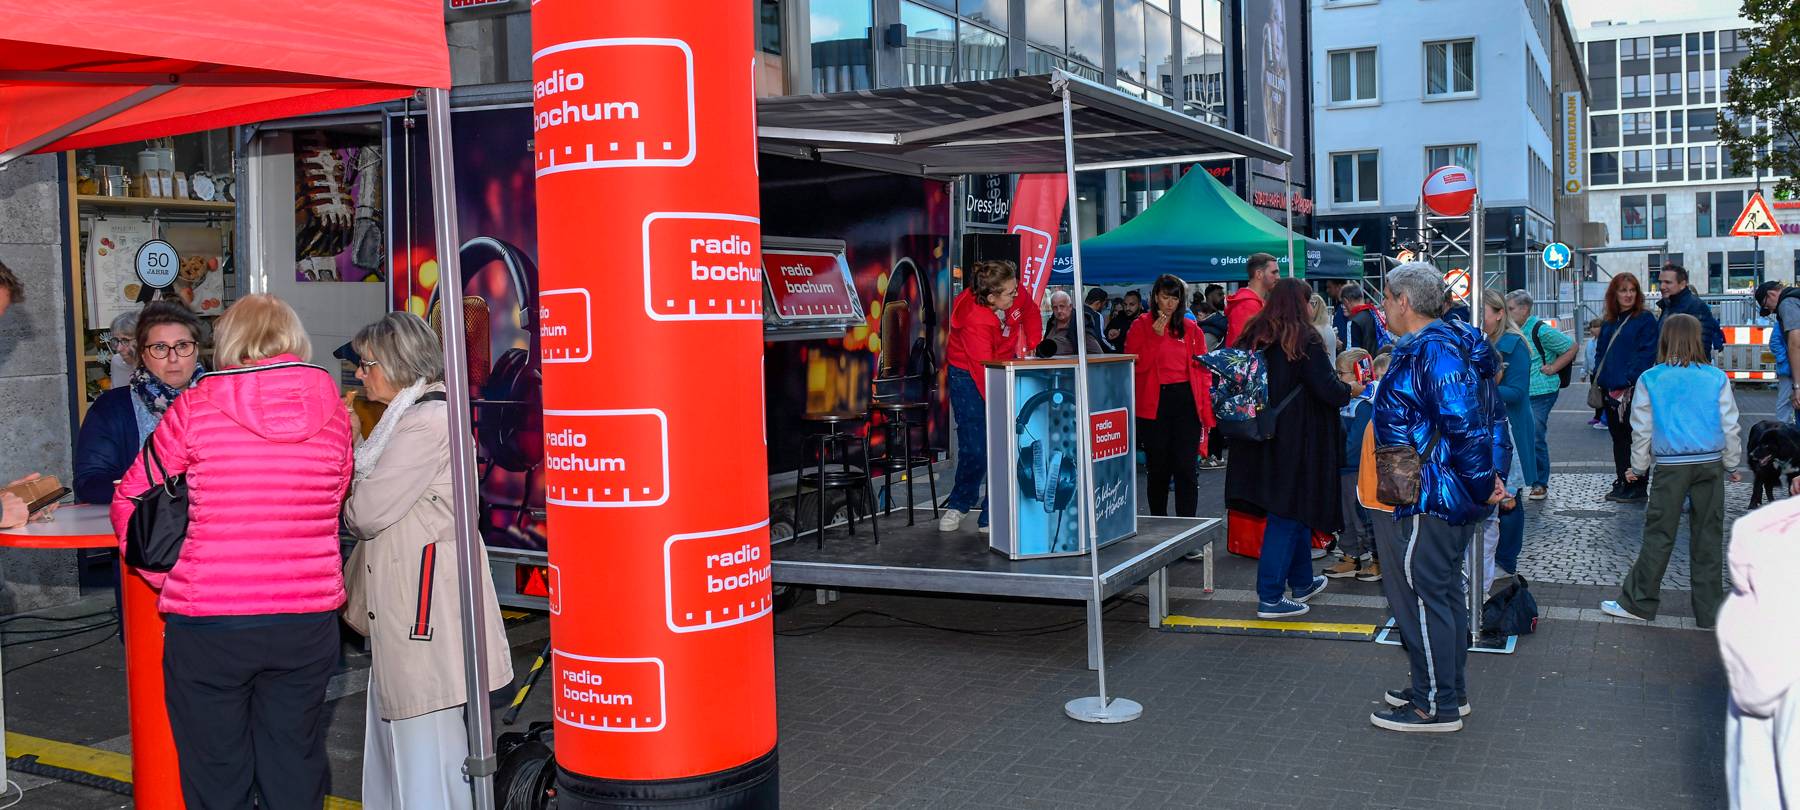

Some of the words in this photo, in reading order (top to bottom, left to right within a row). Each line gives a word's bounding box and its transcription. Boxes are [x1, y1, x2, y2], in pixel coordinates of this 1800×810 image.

[1567, 95, 1578, 176] COMMERZBANK
[967, 194, 992, 213] Dress
[994, 197, 1011, 216] Up!
[690, 234, 751, 256] radio
[148, 252, 169, 268] 50
[780, 263, 814, 277] radio
[785, 279, 836, 294] bochum
[1096, 419, 1112, 430] radio
[546, 428, 587, 448] radio
[1096, 431, 1120, 443] bochum
[546, 450, 626, 472] bochum
[706, 543, 761, 569] radio
[562, 668, 603, 686] radio
[563, 683, 633, 705] bochum
